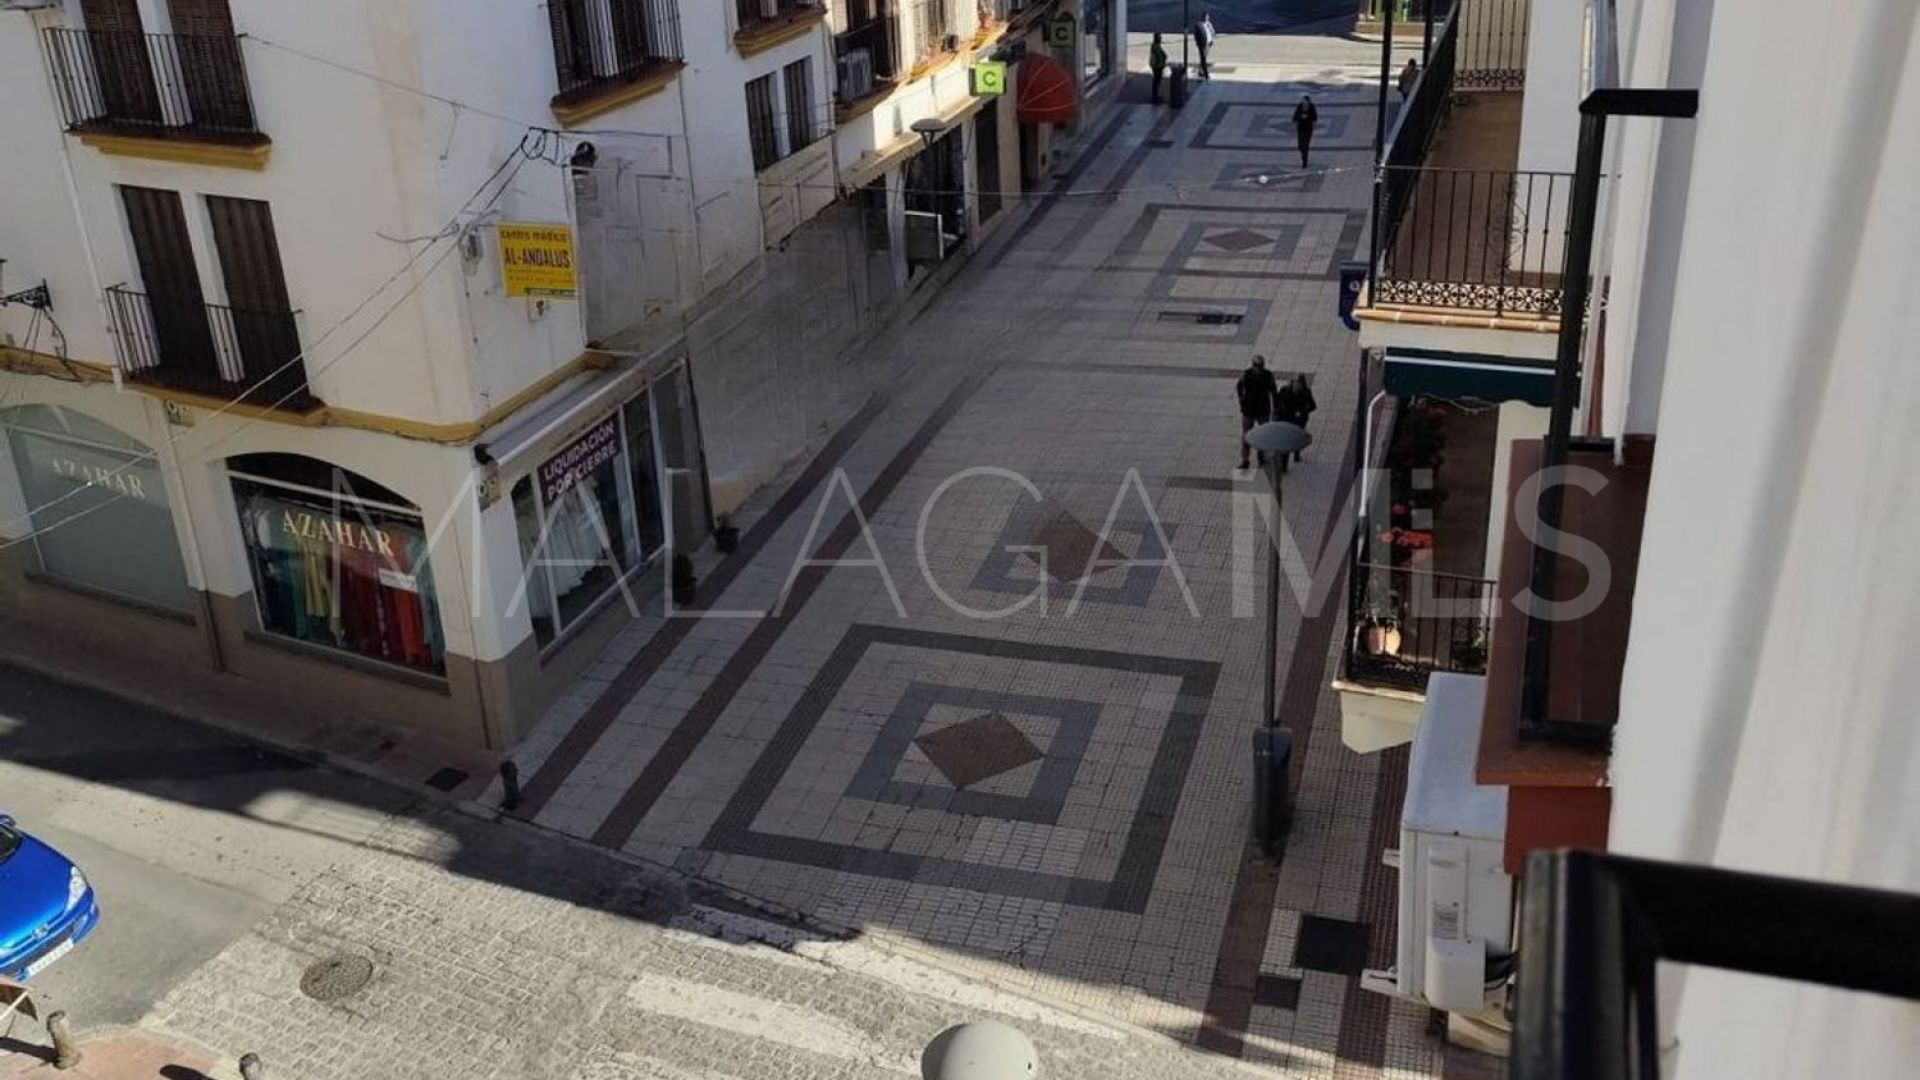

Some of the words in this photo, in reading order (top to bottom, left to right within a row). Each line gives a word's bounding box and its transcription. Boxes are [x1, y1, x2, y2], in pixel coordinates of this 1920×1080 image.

[982, 70, 997, 87] C
[504, 247, 570, 268] AL-ANDALUS
[50, 457, 146, 500] AZAHAR
[546, 472, 573, 502] POR
[576, 439, 617, 479] CIERRE
[283, 509, 394, 557] AZAHAR
